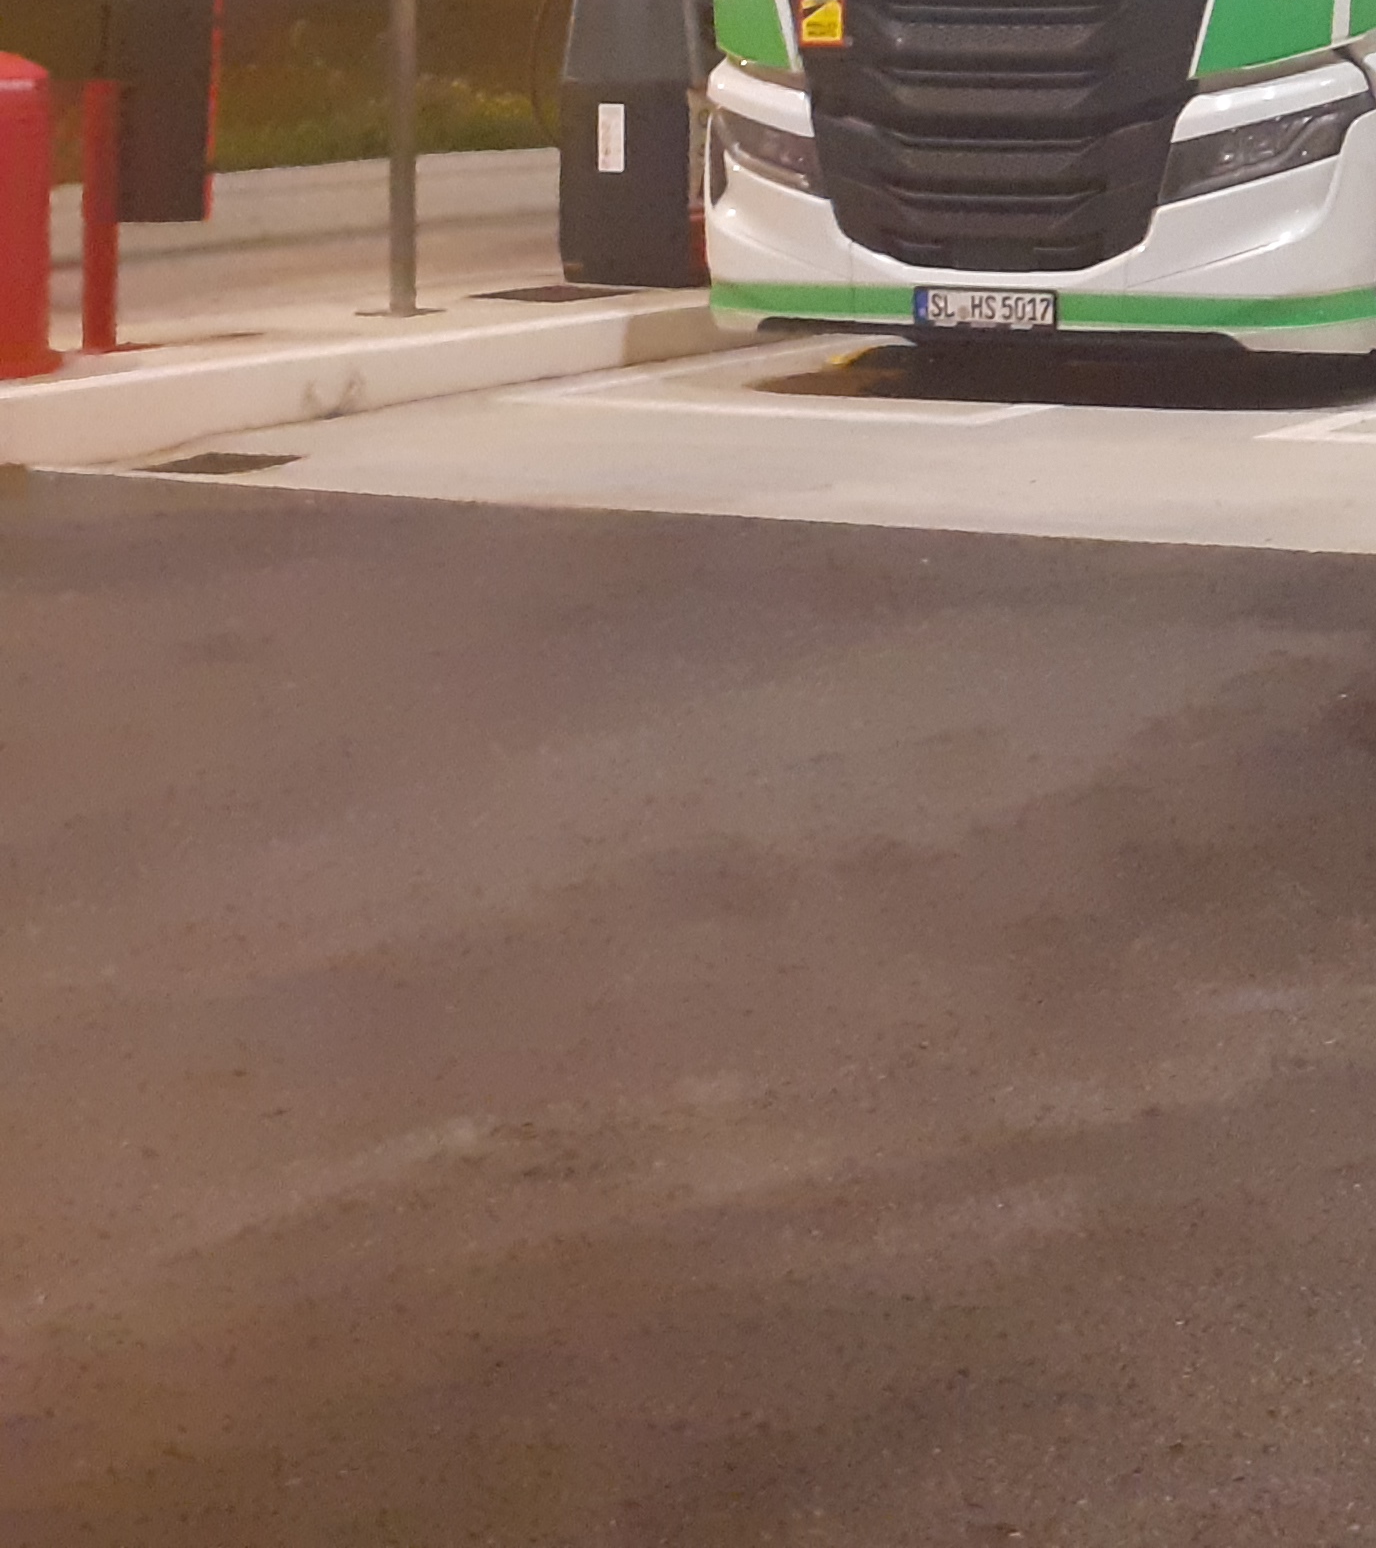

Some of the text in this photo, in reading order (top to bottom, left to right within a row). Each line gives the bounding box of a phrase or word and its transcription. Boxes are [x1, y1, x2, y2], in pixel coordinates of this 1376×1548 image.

[931, 293, 1051, 321] SL HS 5017
